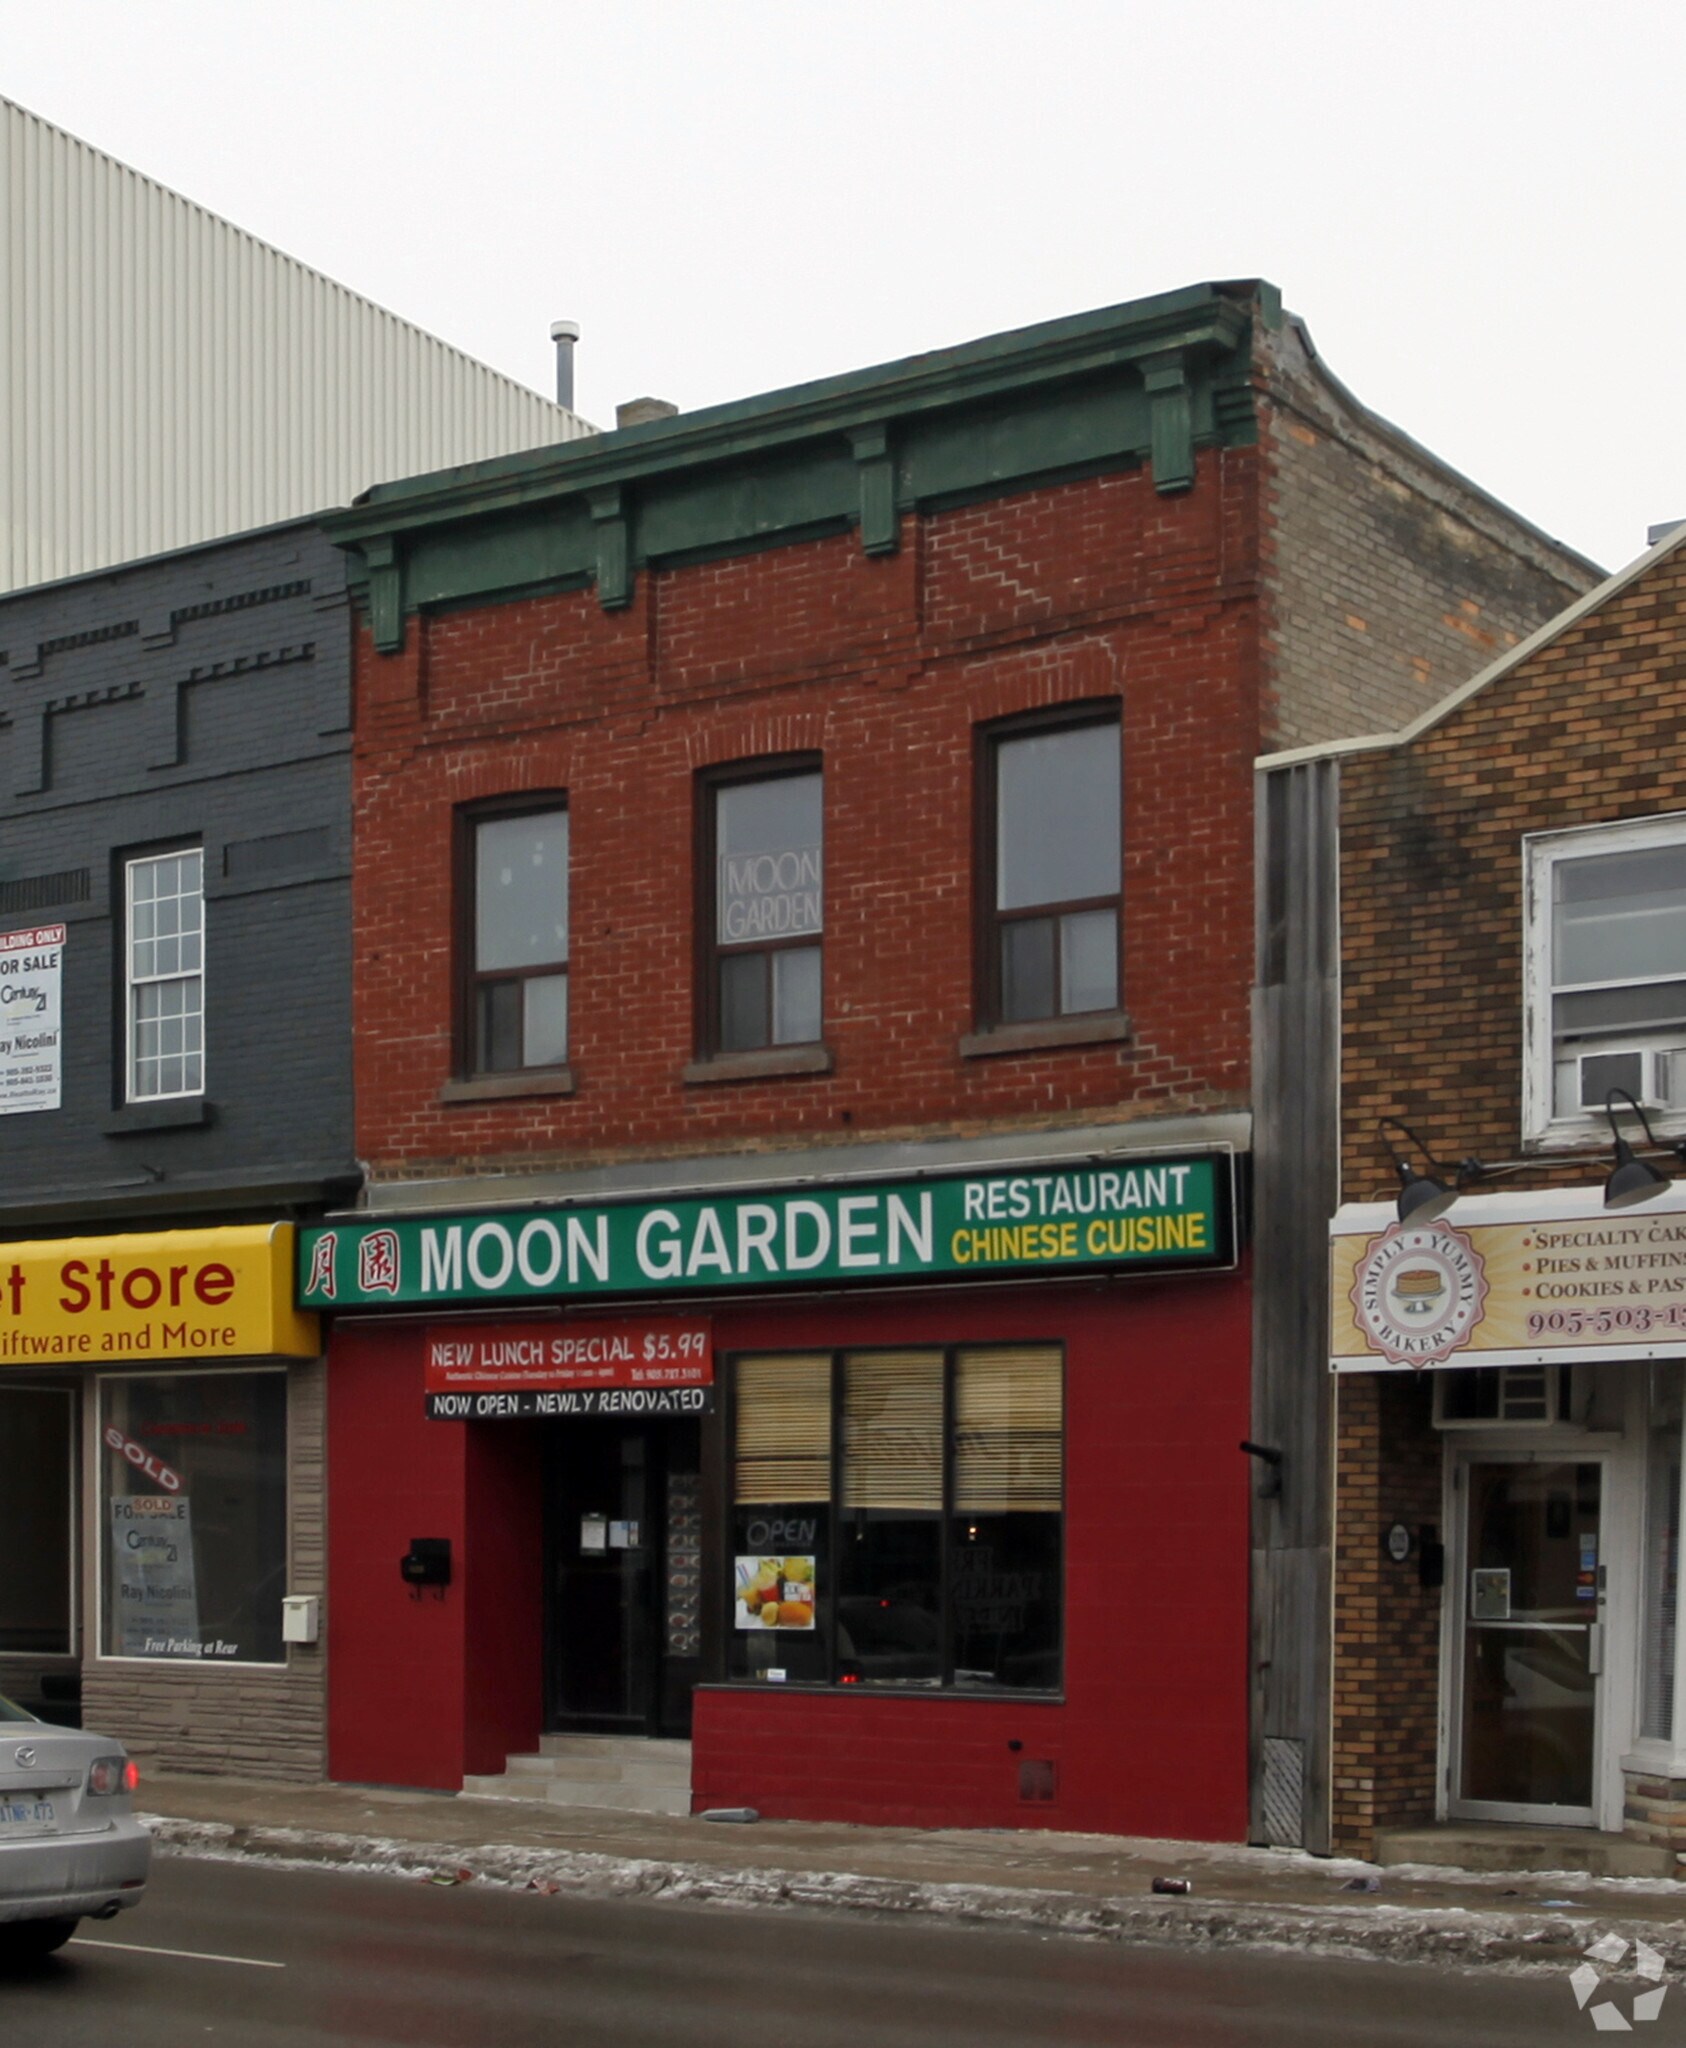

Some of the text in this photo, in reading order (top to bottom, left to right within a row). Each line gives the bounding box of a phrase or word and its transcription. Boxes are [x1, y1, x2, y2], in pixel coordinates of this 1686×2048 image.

[727, 850, 820, 894] MOON
[727, 892, 820, 937] GARDEN
[36, 928, 64, 945] ONLY
[23, 953, 58, 972] SALE
[15, 1031, 57, 1050] Nicolini
[964, 1166, 1190, 1221] RESTAURANT
[420, 1191, 933, 1292] MOON GARDEN
[951, 1213, 1206, 1264] CHINESE CUISINE
[1536, 1229, 1644, 1250] SPECIALTY
[1365, 1236, 1405, 1310] SIMPLY
[1430, 1234, 1473, 1306] YUMMY
[1536, 1257, 1581, 1274] PIES
[1585, 1257, 1598, 1271] &
[0, 1259, 235, 1316] t Store
[1535, 1281, 1624, 1299] COOKIES
[1628, 1280, 1641, 1294] &
[101, 1324, 150, 1351] and
[162, 1322, 236, 1349] More
[431, 1332, 705, 1367] NEW LUNCH SPECIAL $5.99
[1379, 1320, 1456, 1352] BAKERY
[434, 1396, 471, 1415] NOW
[477, 1395, 518, 1415] OPEN
[536, 1392, 594, 1413] NEWLY
[598, 1388, 705, 1412] RENOVATED
[104, 1427, 180, 1490] SOLD
[134, 1499, 172, 1511] SOLD
[747, 1518, 816, 1546] OPEN
[121, 1584, 142, 1602] Ray
[144, 1637, 167, 1652] Free
[167, 1638, 203, 1657] Parking
[215, 1639, 239, 1655] Rear
